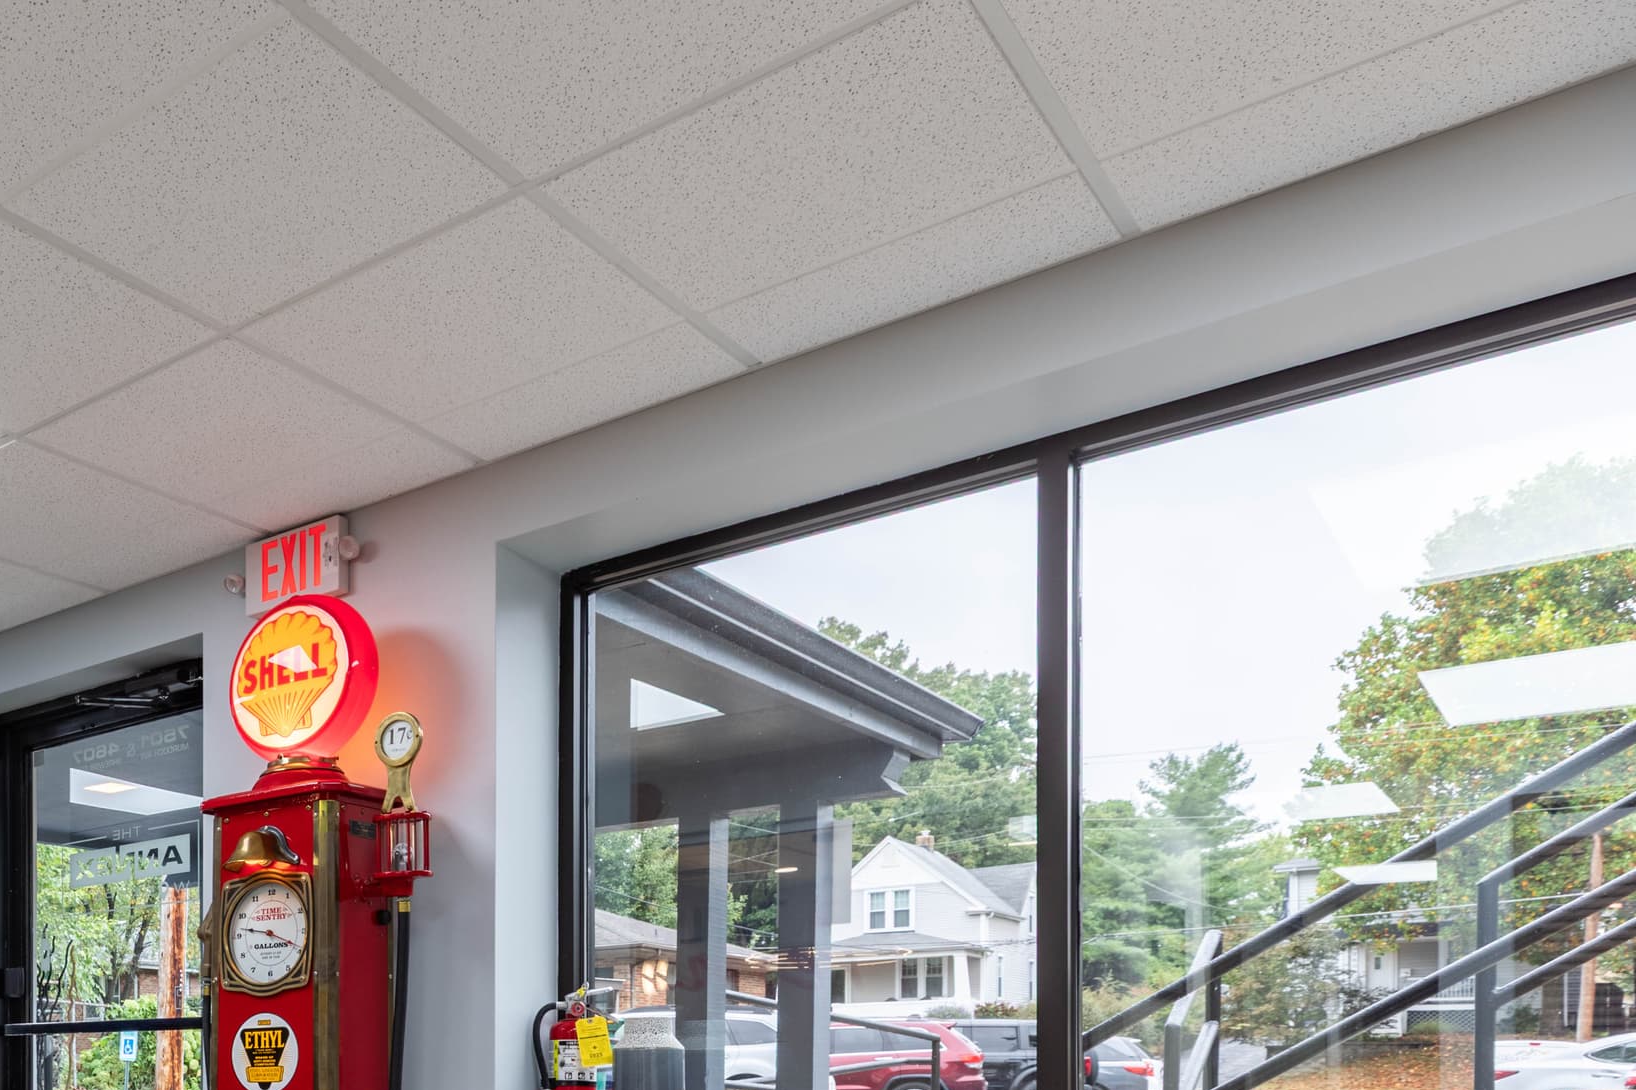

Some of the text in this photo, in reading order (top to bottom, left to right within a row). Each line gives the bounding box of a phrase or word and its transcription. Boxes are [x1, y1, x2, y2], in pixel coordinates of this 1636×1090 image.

[261, 524, 326, 602] EXIT
[243, 643, 328, 694] SHELL
[244, 1030, 285, 1050] ETHYL
